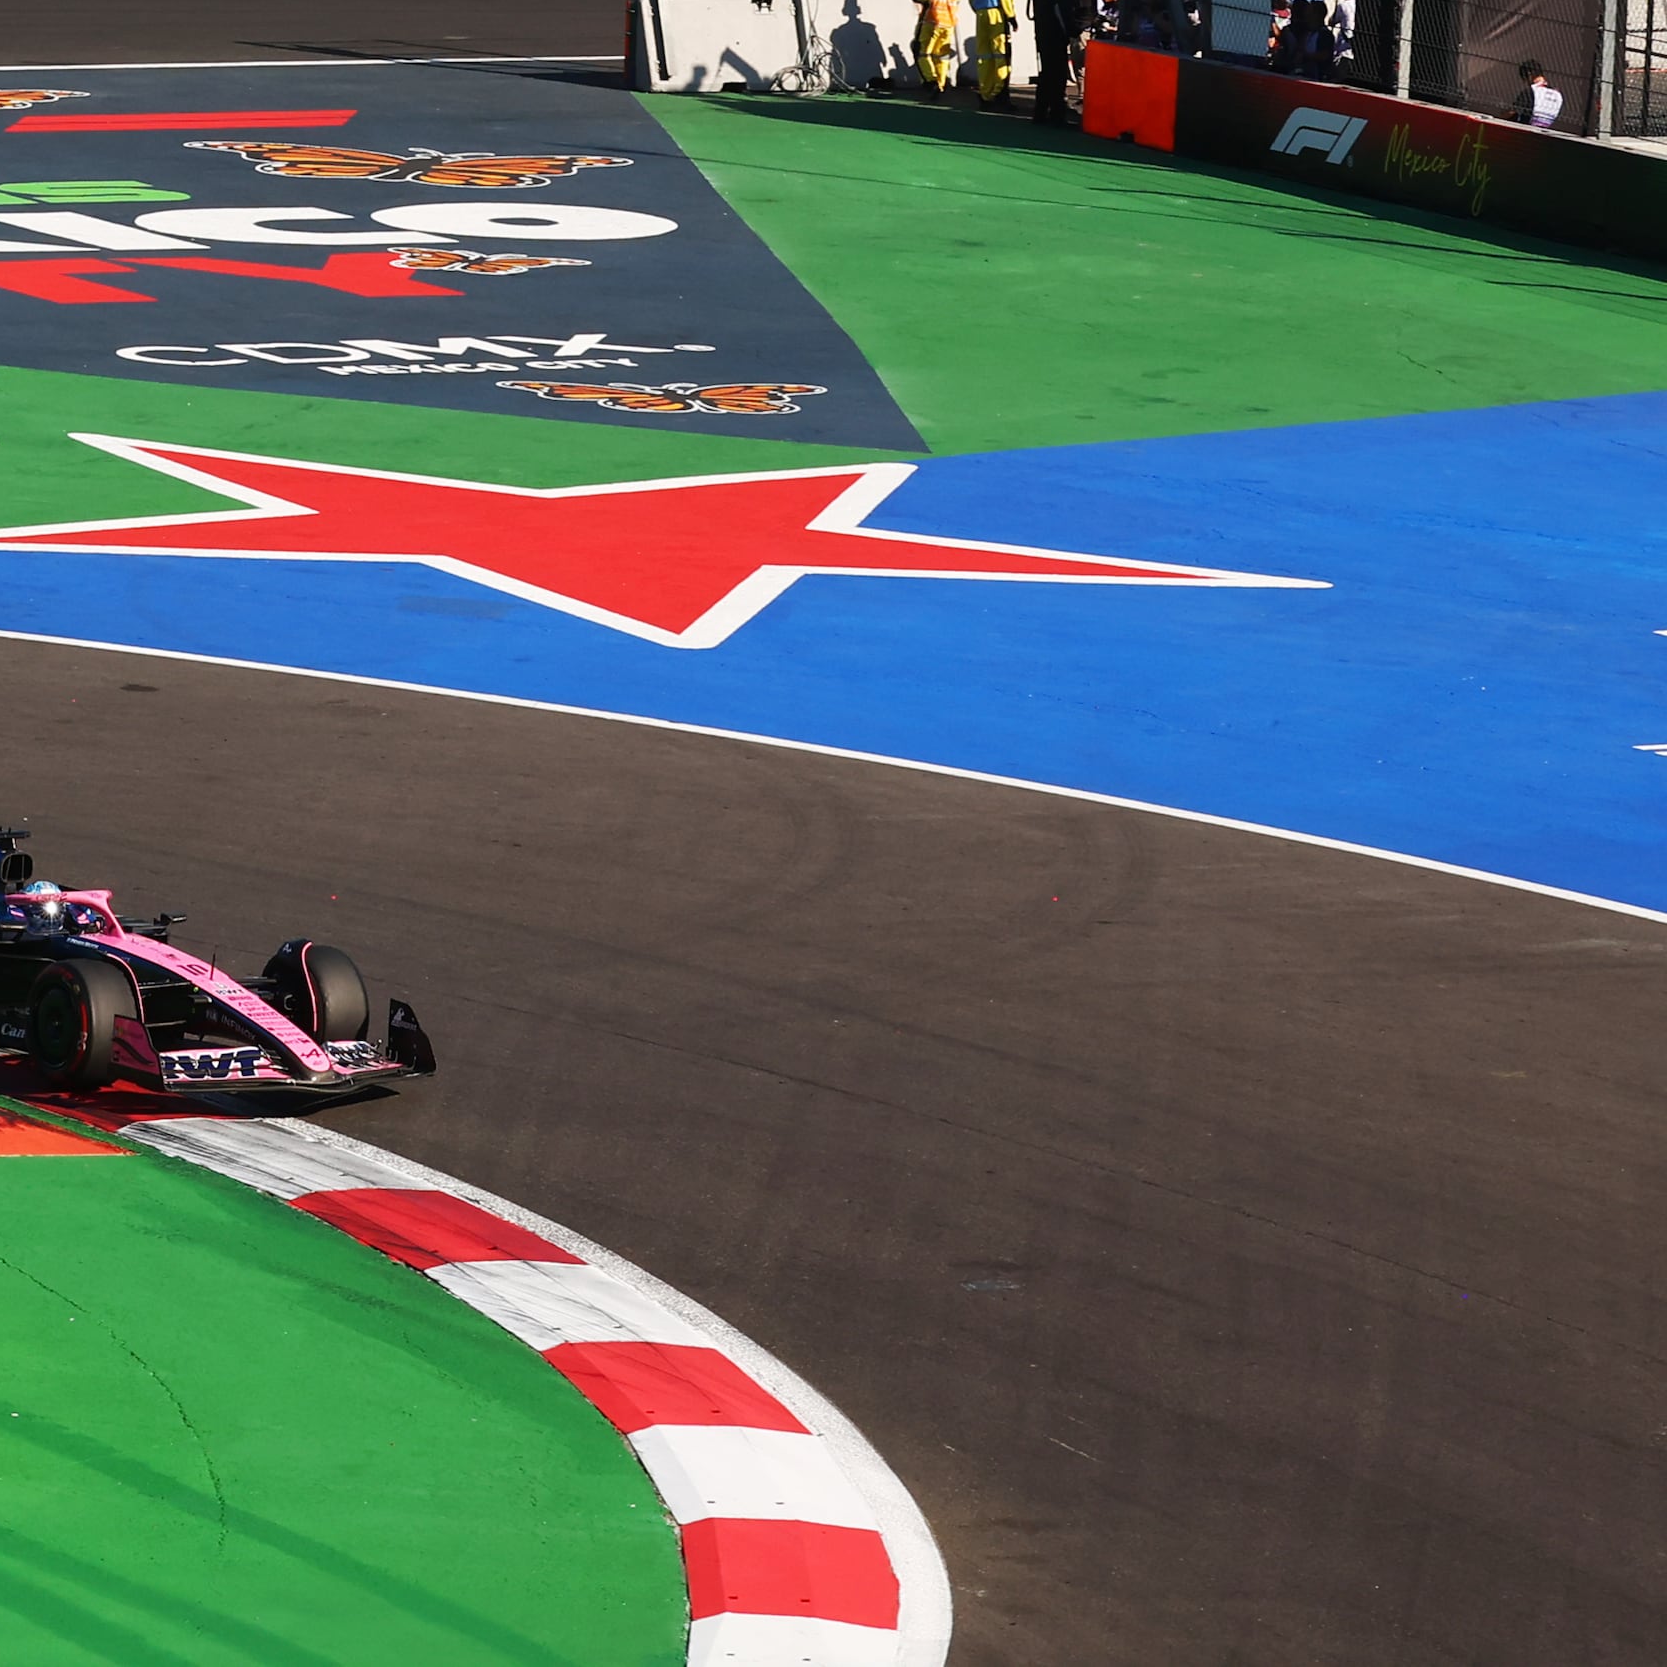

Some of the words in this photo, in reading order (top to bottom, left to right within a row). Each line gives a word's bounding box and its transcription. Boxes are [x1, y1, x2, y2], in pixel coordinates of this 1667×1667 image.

[1385, 124, 1451, 182] Mexico
[1455, 122, 1492, 216] City
[115, 333, 675, 367] CDMX
[317, 362, 520, 376] MEXICO
